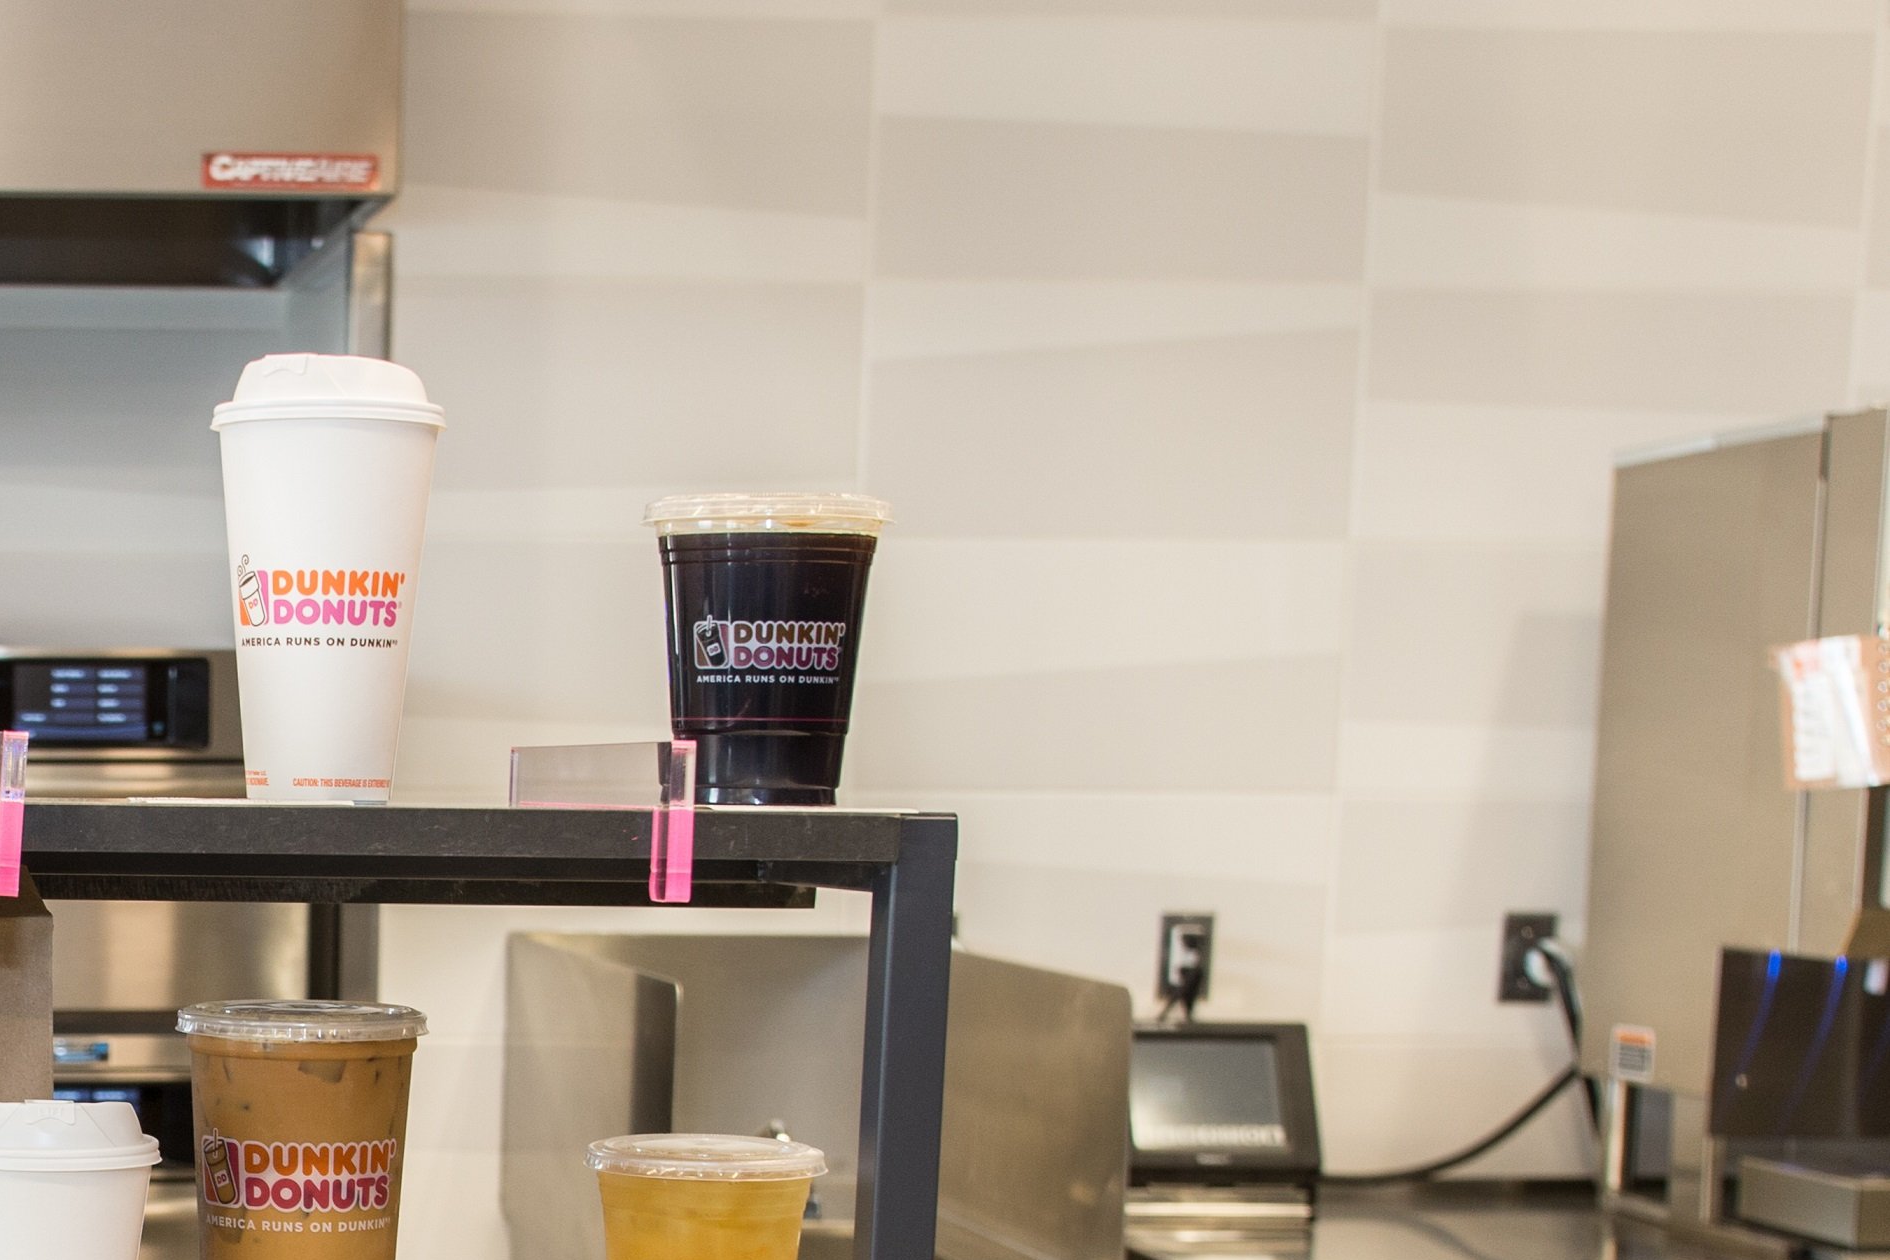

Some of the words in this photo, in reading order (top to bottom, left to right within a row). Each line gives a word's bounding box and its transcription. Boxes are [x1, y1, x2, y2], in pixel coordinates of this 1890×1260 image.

[272, 569, 405, 598] DUNKIN'
[273, 598, 398, 628] DONUTS
[241, 637, 281, 647] AMERICA
[286, 637, 321, 646] RUNS
[326, 637, 345, 647] ON
[733, 622, 846, 646] DUNKIN'
[733, 645, 839, 669] DONUTS
[696, 675, 741, 683] AMERICA
[745, 675, 775, 683] RUNS
[779, 675, 795, 683] ON
[320, 778, 332, 787] THIS
[243, 1139, 396, 1176] DUNKIN'
[245, 1175, 389, 1209] DONUTS
[206, 1216, 257, 1231] AMERICA
[262, 1220, 304, 1232] RUNS
[310, 1221, 333, 1233] ON
